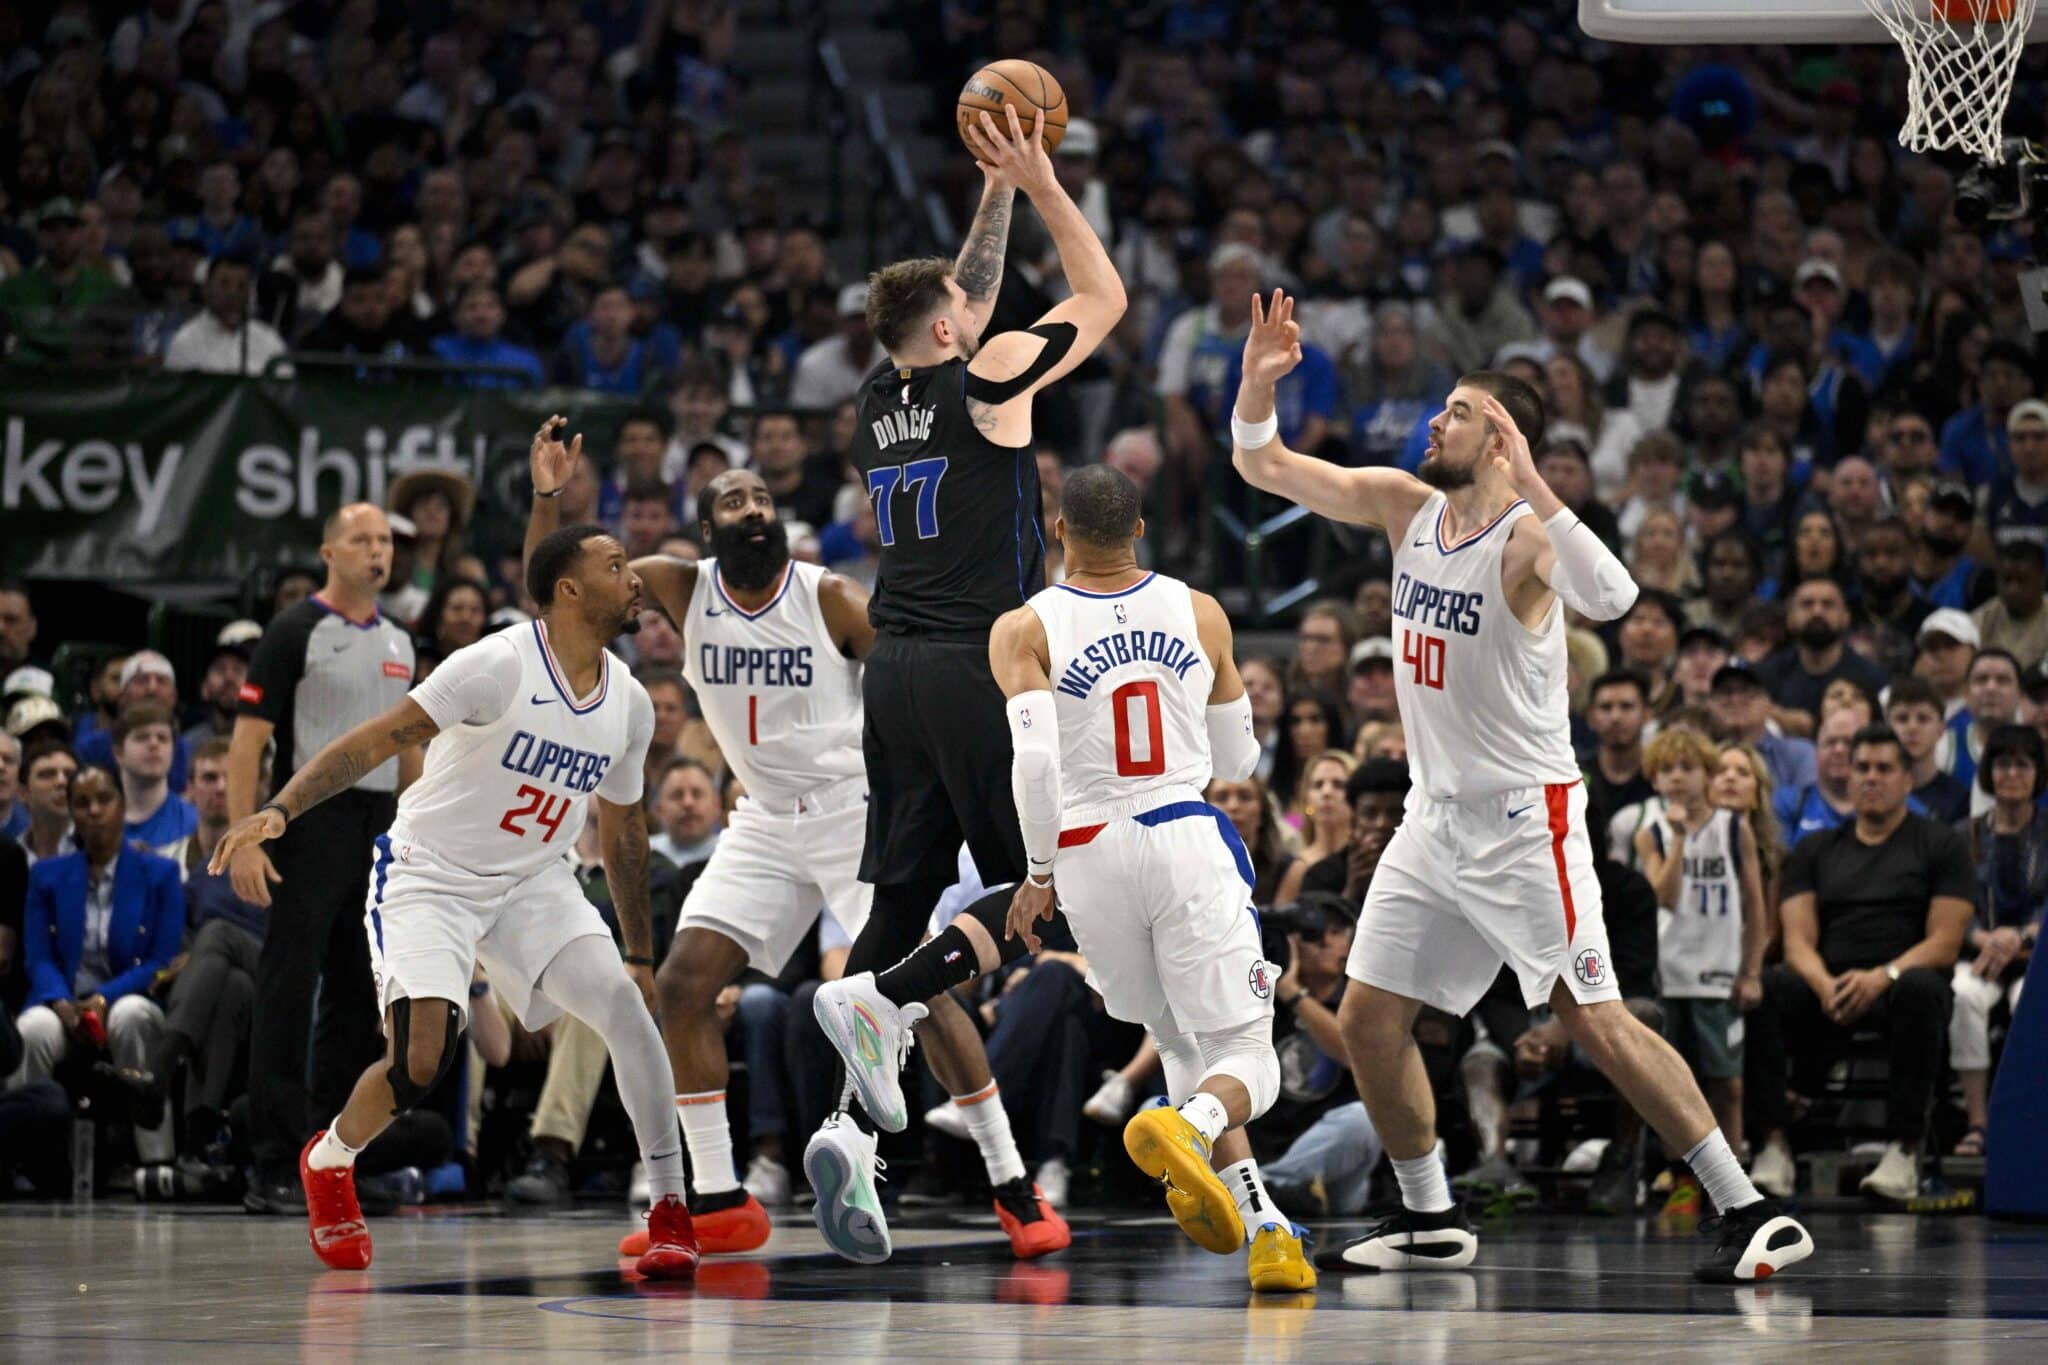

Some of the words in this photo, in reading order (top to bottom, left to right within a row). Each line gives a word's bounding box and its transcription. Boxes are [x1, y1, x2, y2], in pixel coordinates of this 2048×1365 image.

[872, 403, 937, 450] DONČIĆ
[2, 418, 183, 536] key
[867, 456, 949, 546] 77
[1393, 571, 1483, 637] CLIPPERS
[701, 643, 813, 688] CLIPPERS
[1057, 630, 1200, 700] WESTBROOK
[1403, 628, 1446, 690] 40
[501, 729, 611, 793] CLIPPERS
[1112, 680, 1166, 777] 0
[499, 783, 572, 843] 24
